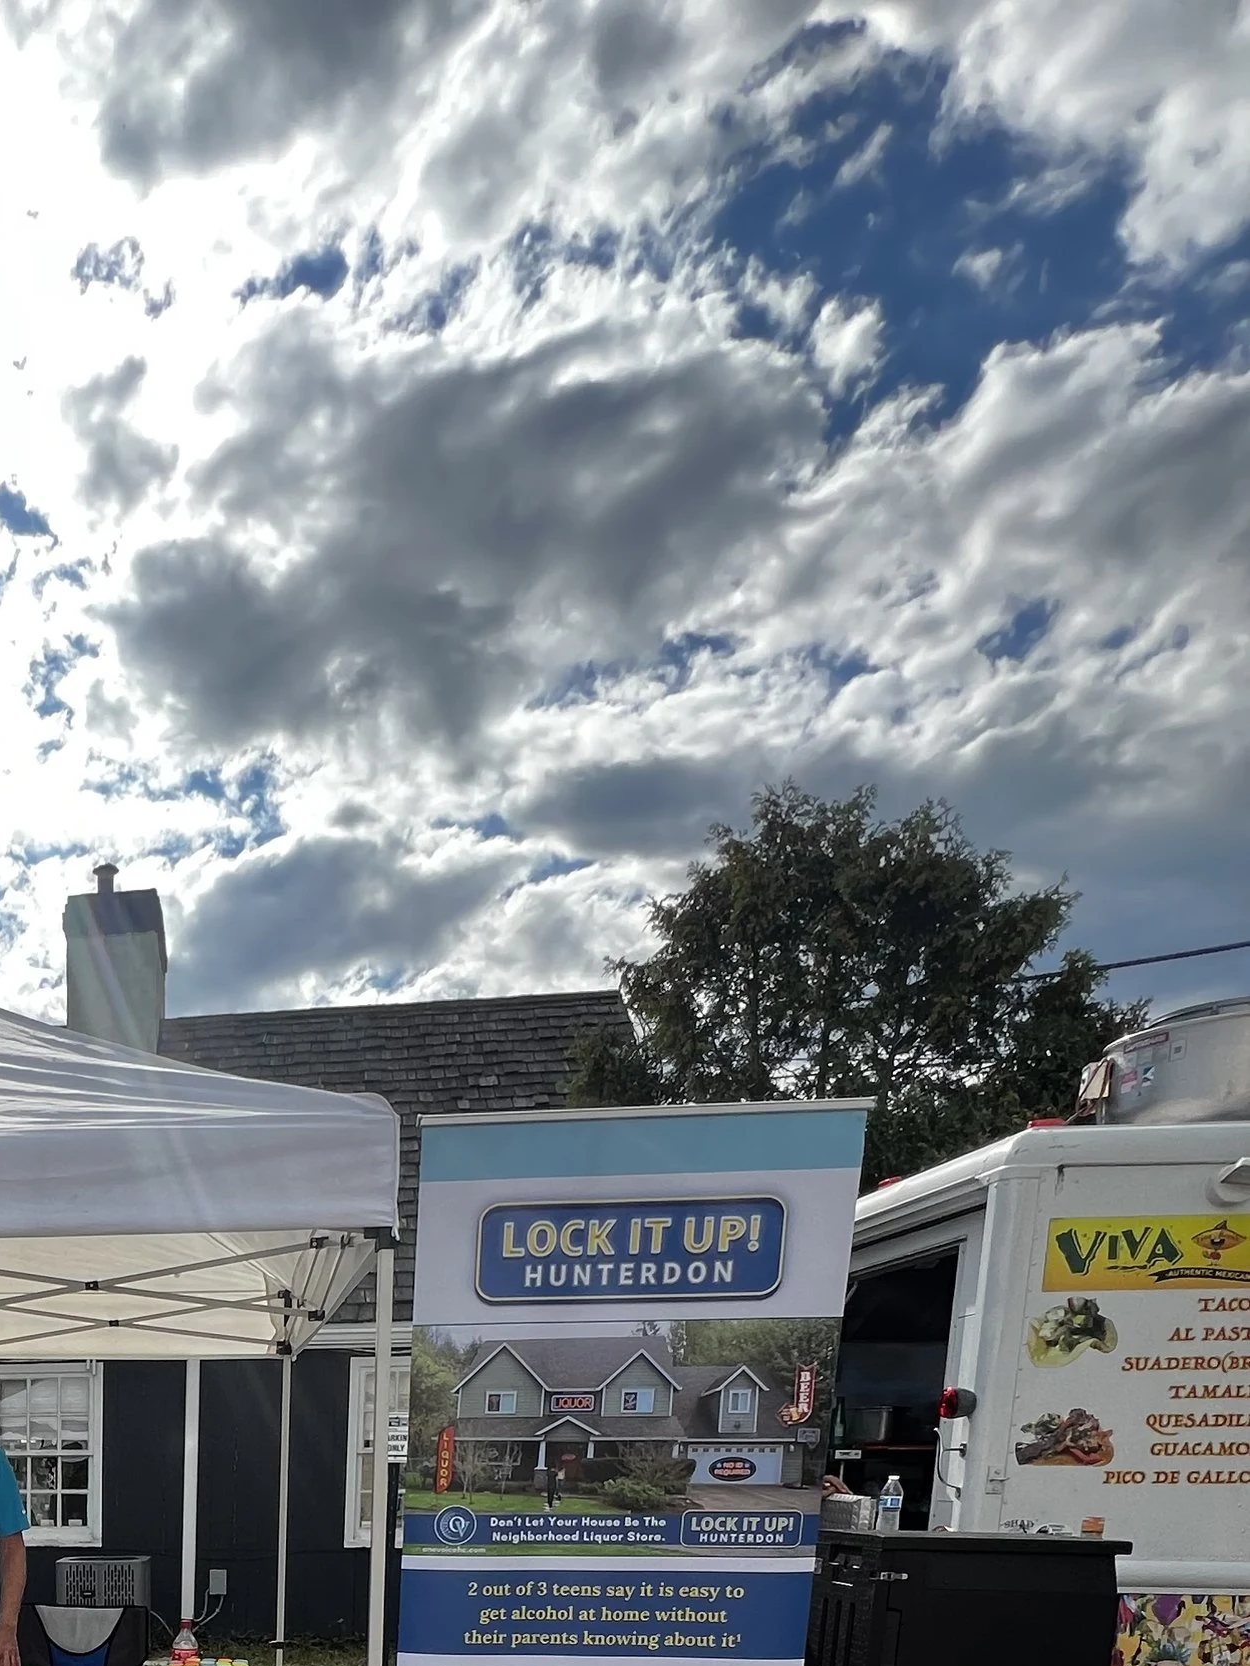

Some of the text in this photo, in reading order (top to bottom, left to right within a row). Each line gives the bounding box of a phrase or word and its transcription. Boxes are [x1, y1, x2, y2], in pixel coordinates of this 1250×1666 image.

[502, 1214, 762, 1258] LOCK IT UP!
[1056, 1226, 1184, 1276] VIVA
[524, 1259, 735, 1288] HUNTERDON
[1169, 1268, 1213, 1277] AUTHENTIC
[1168, 1327, 1196, 1341] AL
[554, 1397, 592, 1409] LIQUOR
[440, 1432, 450, 1486] LIQUOR
[1103, 1470, 1145, 1484] PICO
[1152, 1470, 1180, 1484] DE
[490, 1516, 667, 1527] Don't Let Your House Be The
[691, 1517, 794, 1531] LOCK IT UP!
[492, 1531, 579, 1544] Neighborhood
[583, 1531, 623, 1543] Liquor
[699, 1533, 784, 1543] HUNTERDON
[468, 1581, 745, 1602] 2 out of 3 teens say it is easy to
[479, 1606, 728, 1625] get alcohol at home without
[463, 1630, 507, 1644] their
[511, 1632, 578, 1648] parents
[583, 1631, 661, 1650] knowing
[664, 1632, 716, 1647] about
